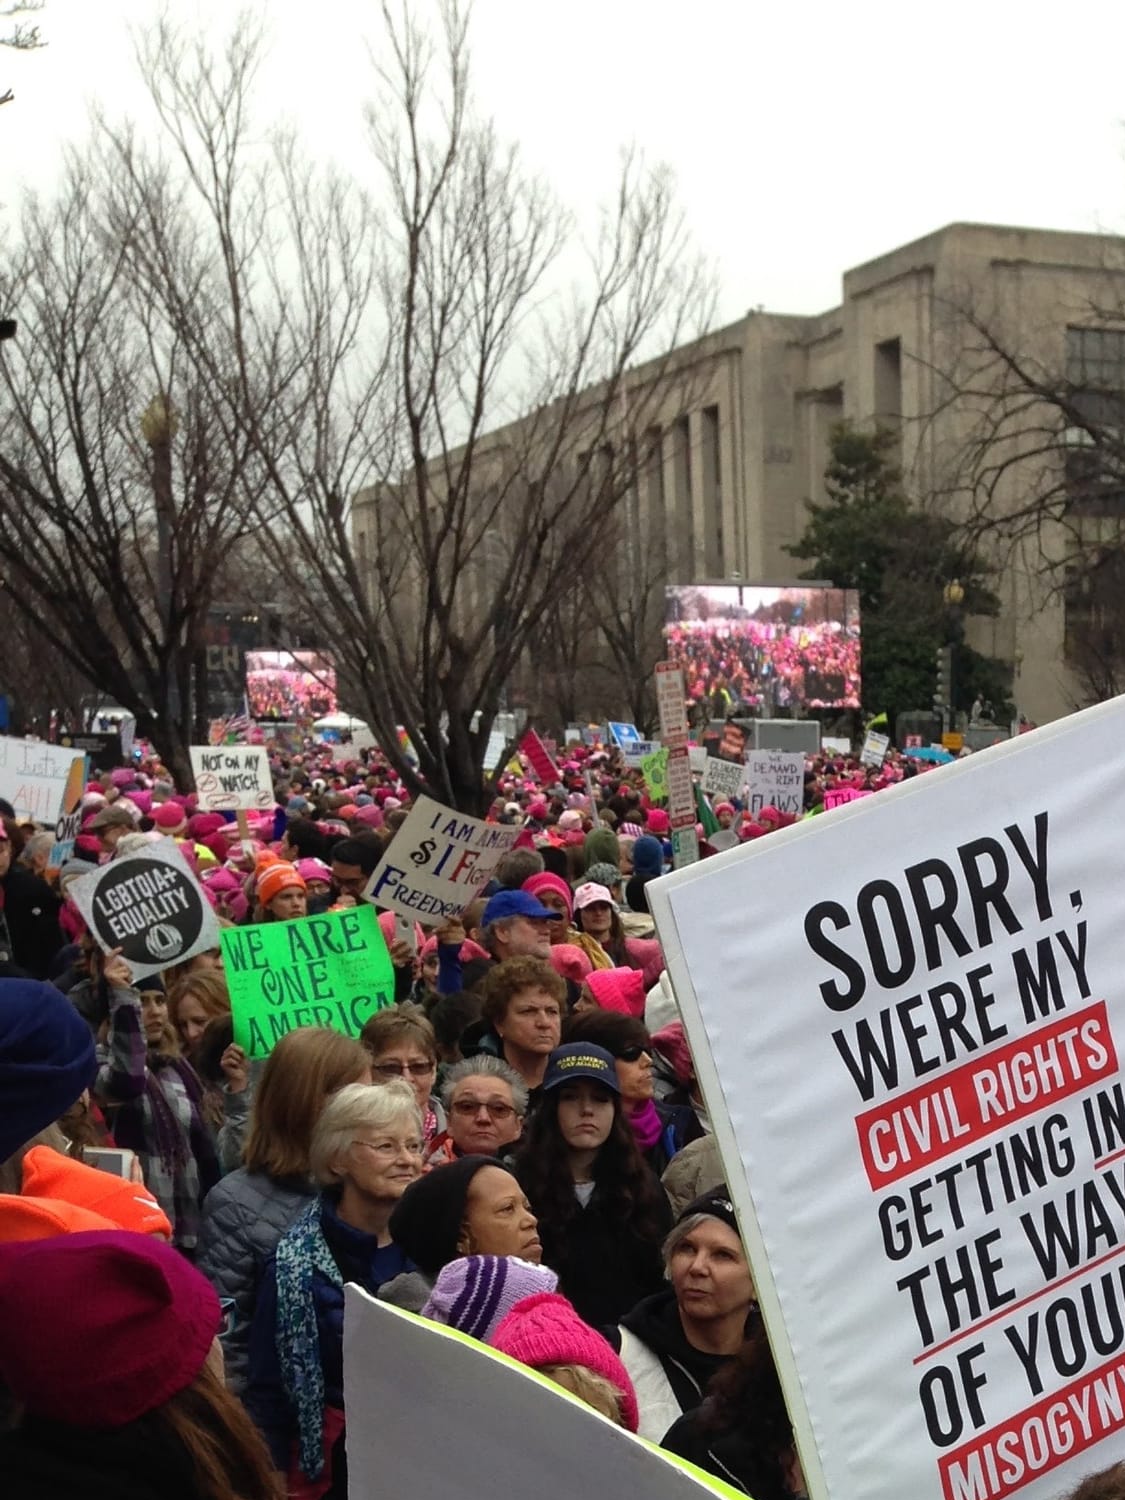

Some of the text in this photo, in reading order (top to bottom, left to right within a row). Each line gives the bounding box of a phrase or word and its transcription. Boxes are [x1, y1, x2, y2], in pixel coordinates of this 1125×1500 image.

[202, 754, 223, 771] NOT
[245, 755, 260, 771] MY
[219, 774, 260, 792] WATCH
[430, 812, 442, 829] I
[442, 819, 476, 843] AM
[95, 867, 178, 917] LGBTQIA+
[109, 886, 190, 940] EQUALITY
[803, 811, 1083, 1013] SORRY,
[223, 913, 367, 971] WE ARE
[260, 961, 335, 1006] ONE
[832, 920, 1092, 1102] WERE MY
[868, 1019, 1109, 1173] CIVIL RIGHTS
[878, 1113, 1076, 1261] GETTING
[897, 1228, 1015, 1348] THE
[919, 1342, 987, 1447] OF
